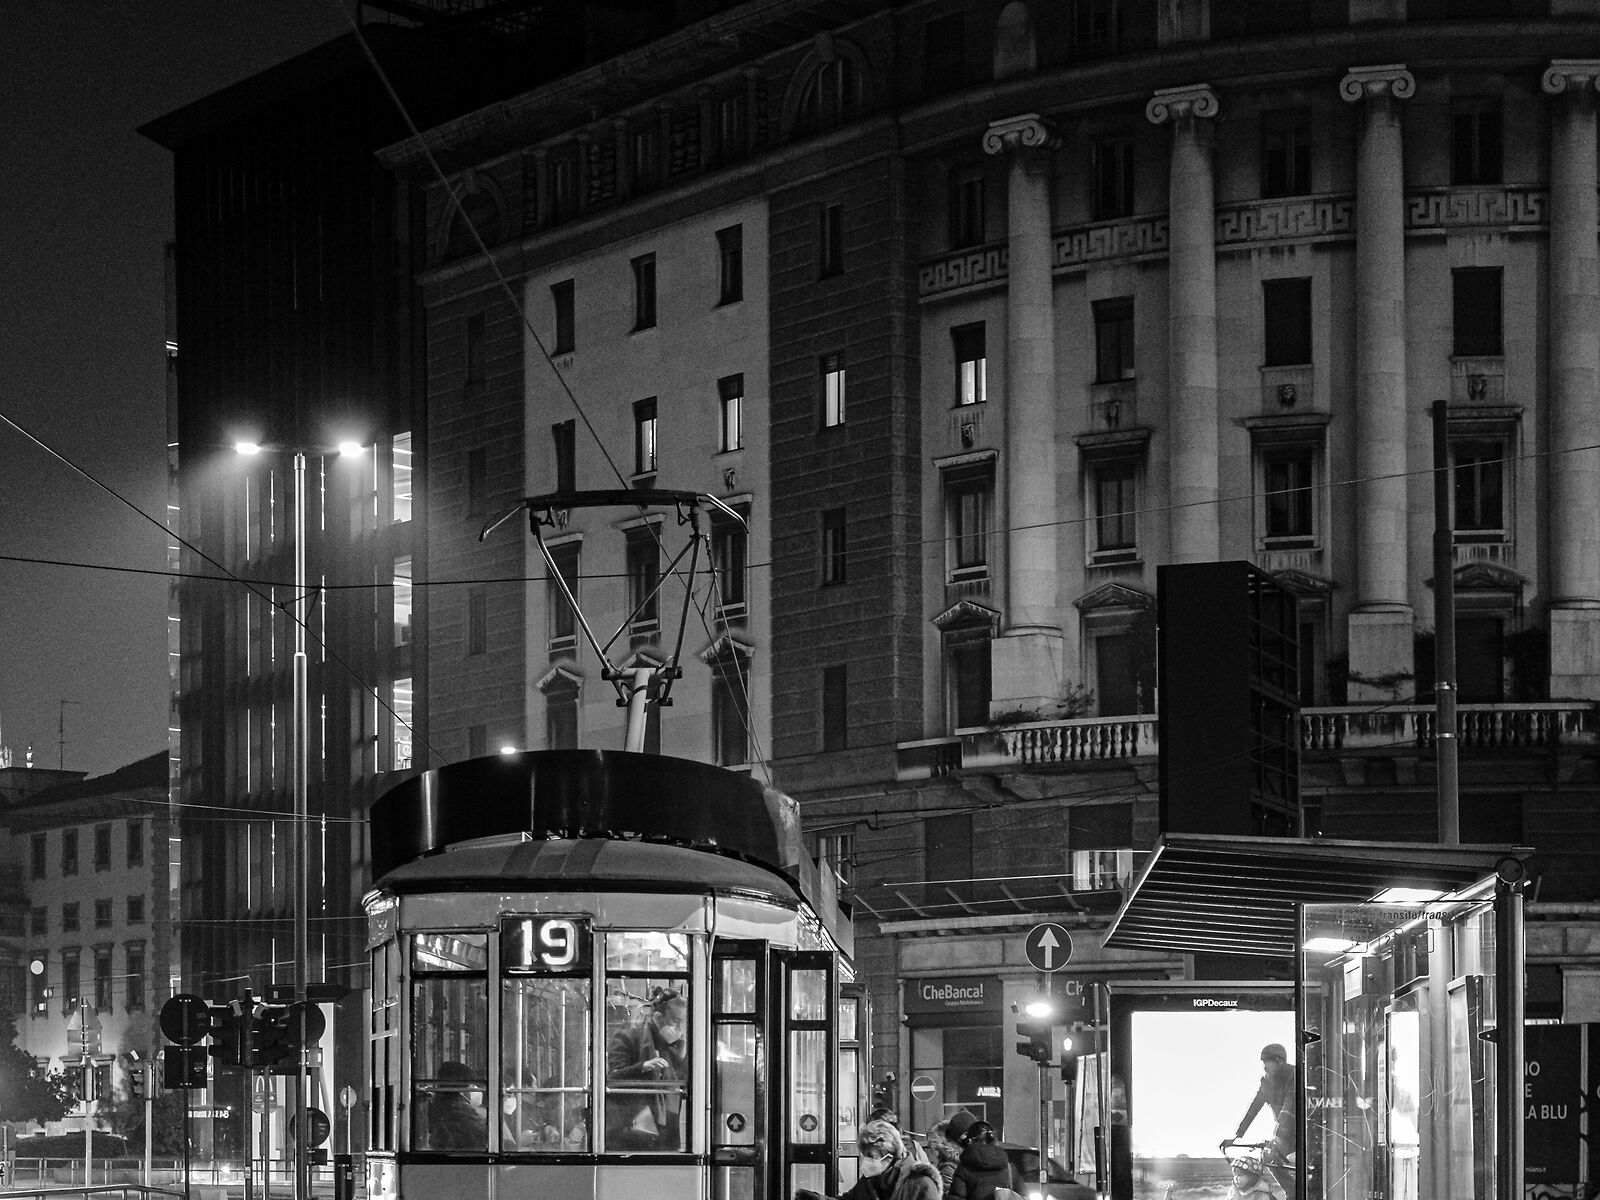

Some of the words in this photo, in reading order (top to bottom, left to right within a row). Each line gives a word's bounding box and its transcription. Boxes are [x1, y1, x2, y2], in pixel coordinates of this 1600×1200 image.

[520, 919, 577, 967] 19
[923, 983, 984, 1000] CheBanca!
[1193, 998, 1239, 1007] IGPDecaux
[1541, 1104, 1567, 1120] BLU
